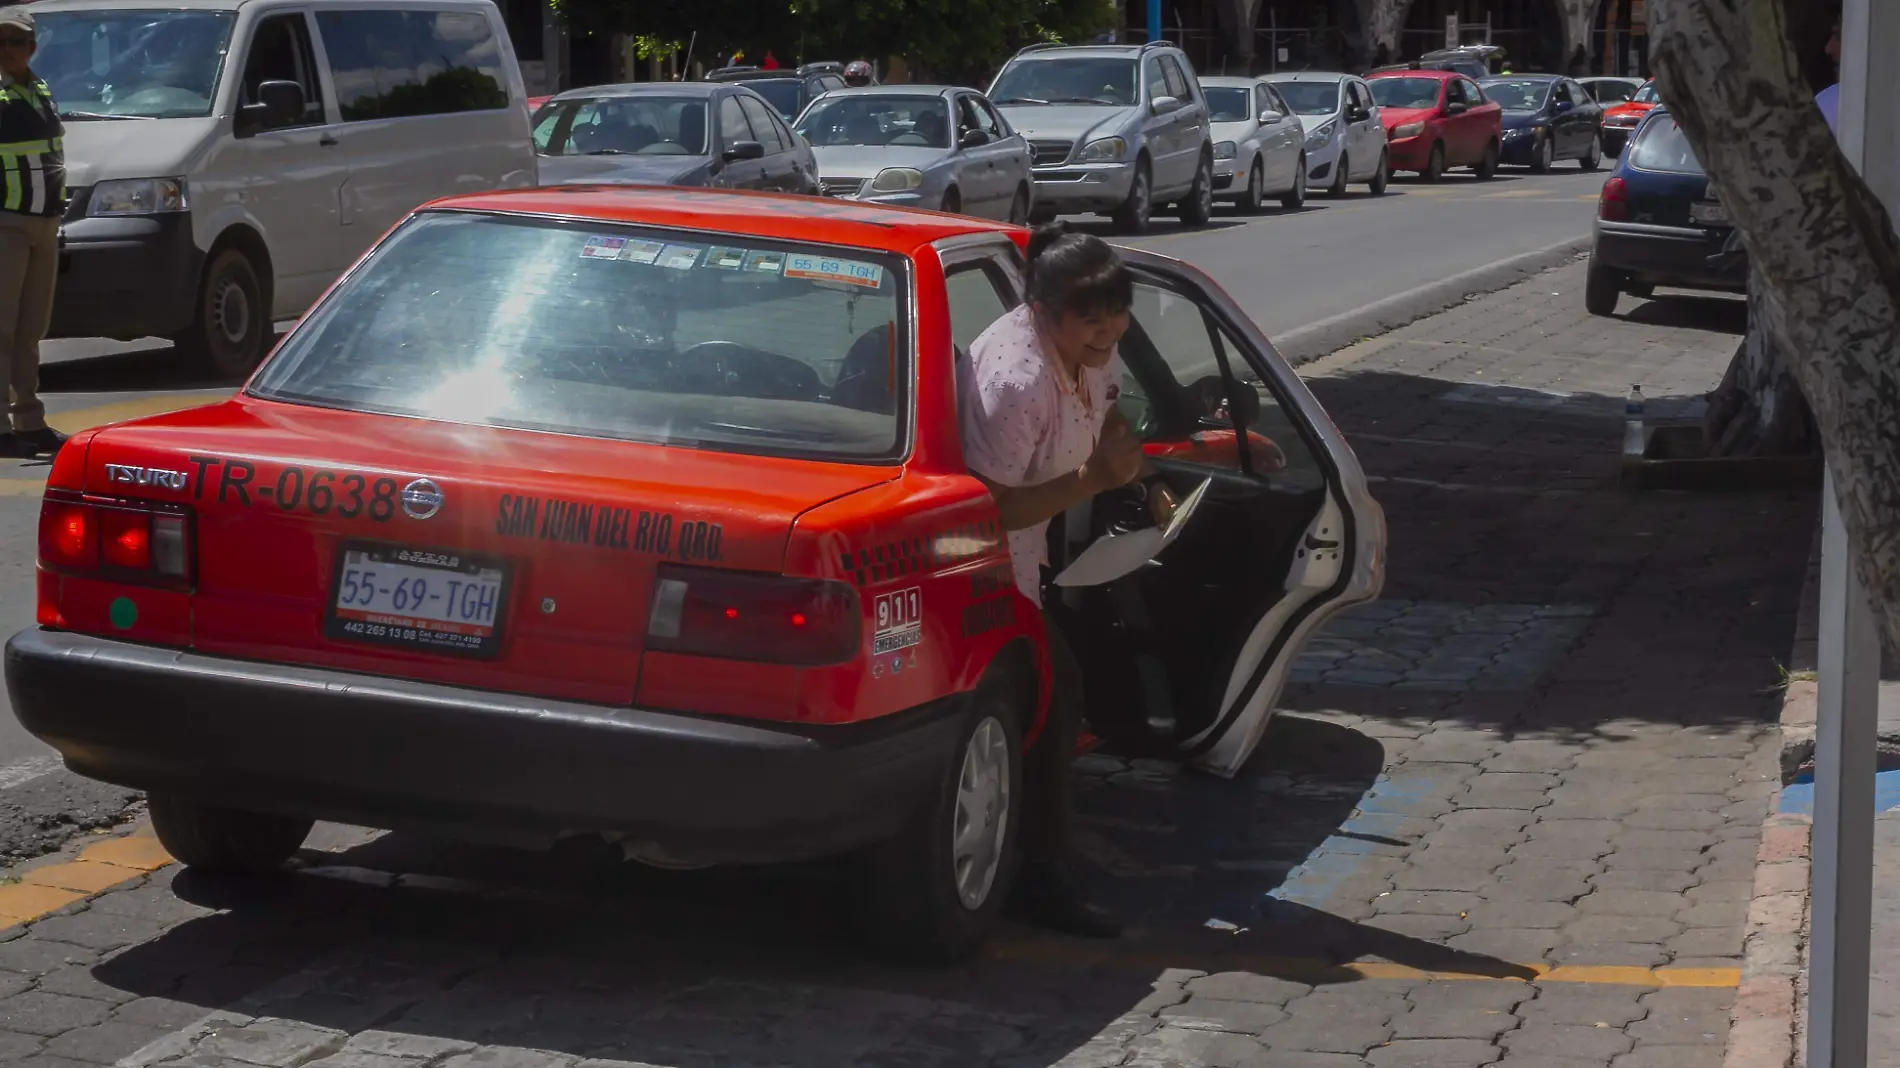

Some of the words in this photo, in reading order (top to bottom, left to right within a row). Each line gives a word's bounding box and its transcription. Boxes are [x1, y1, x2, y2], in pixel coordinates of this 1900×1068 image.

[105, 463, 188, 489] TSURU
[188, 455, 397, 522] TR-0638
[496, 493, 539, 538] SAN
[539, 498, 595, 544] JUAN
[595, 506, 631, 549] DEL
[342, 569, 496, 622] 55-69-TGH
[879, 592, 917, 626] 911
[344, 621, 364, 633] 442
[365, 624, 386, 636] 265
[388, 627, 401, 638] 13
[875, 628, 920, 653] EMERGENCIAS
